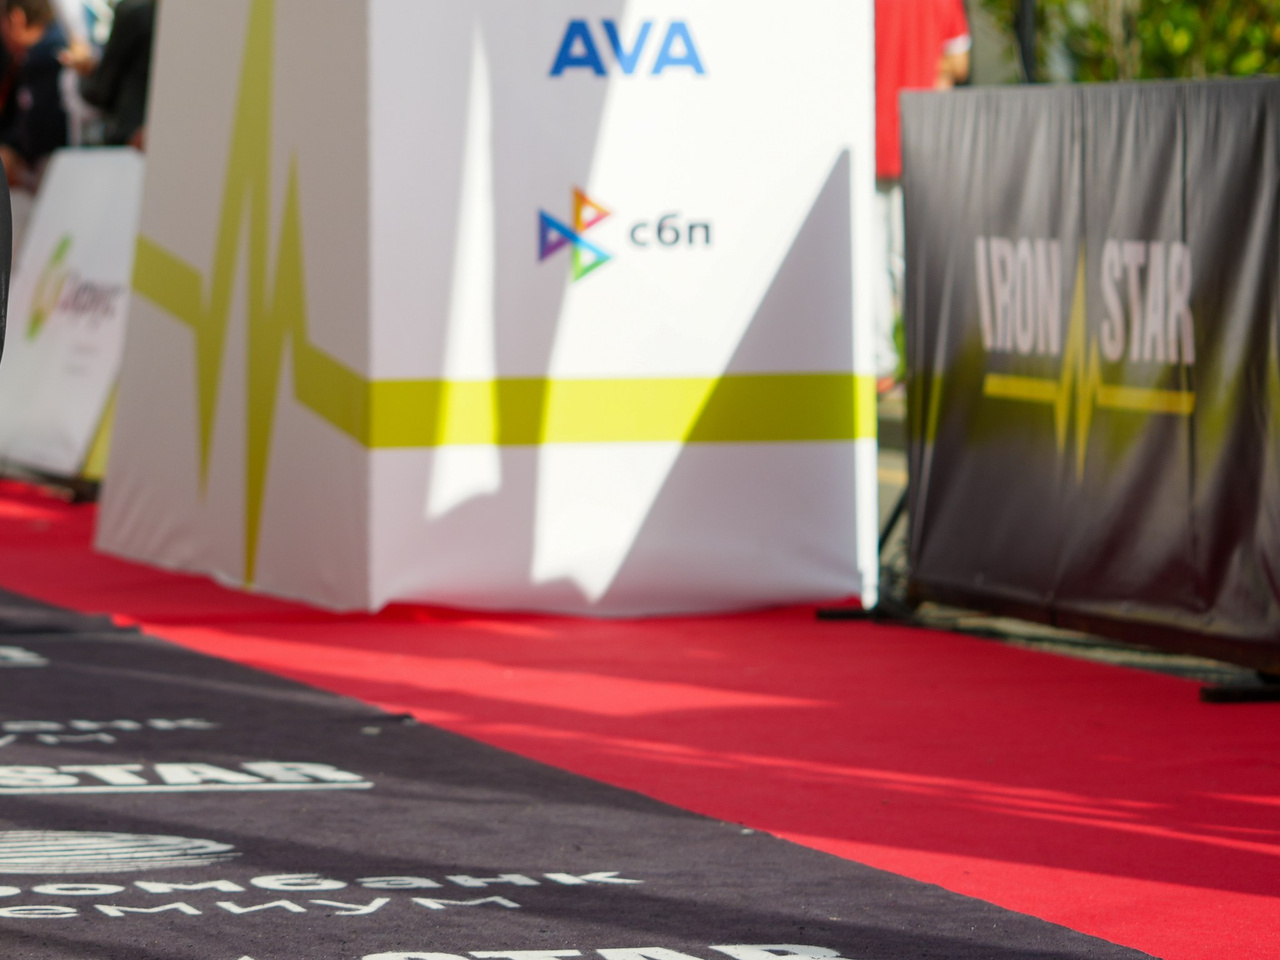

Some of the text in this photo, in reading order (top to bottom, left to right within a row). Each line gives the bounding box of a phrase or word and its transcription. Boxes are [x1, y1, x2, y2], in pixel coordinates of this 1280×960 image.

[548, 18, 707, 77] AVA
[630, 210, 711, 246] сбп
[974, 235, 1196, 367] IRON STAR
